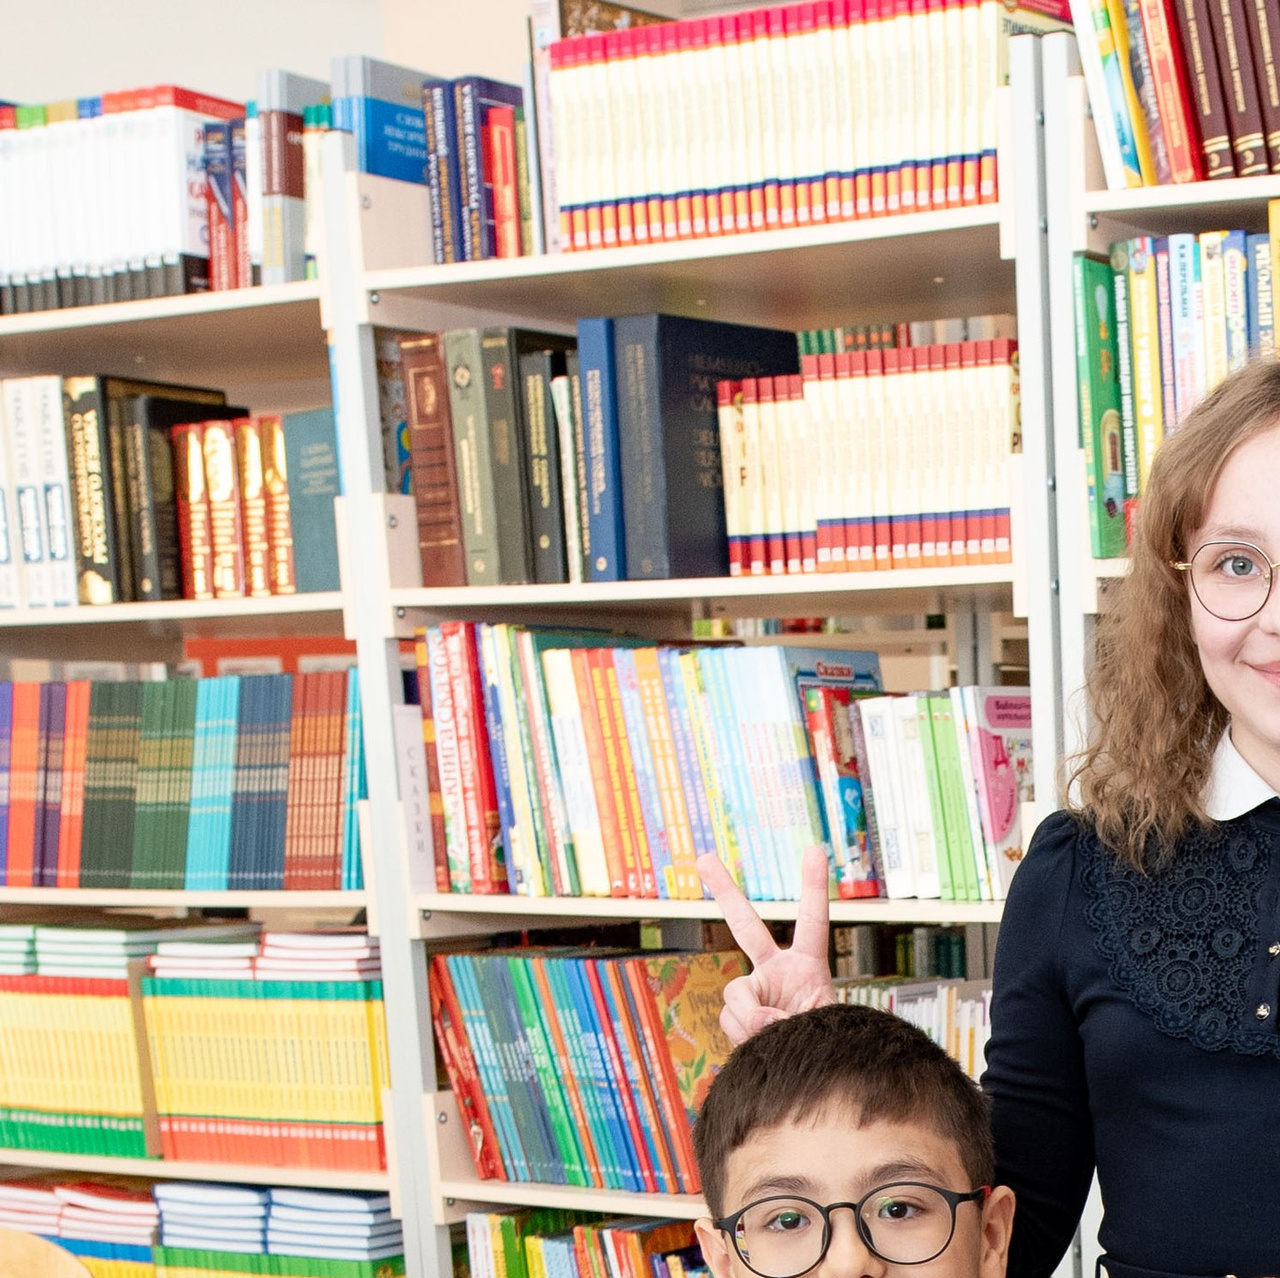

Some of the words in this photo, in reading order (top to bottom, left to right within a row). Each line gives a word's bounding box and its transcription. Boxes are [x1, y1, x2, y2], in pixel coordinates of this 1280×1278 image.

[1255, 243, 1274, 327] ПРИРОДЫ
[816, 661, 855, 680] Сказки
[406, 745, 425, 853] СКАЗКИ
